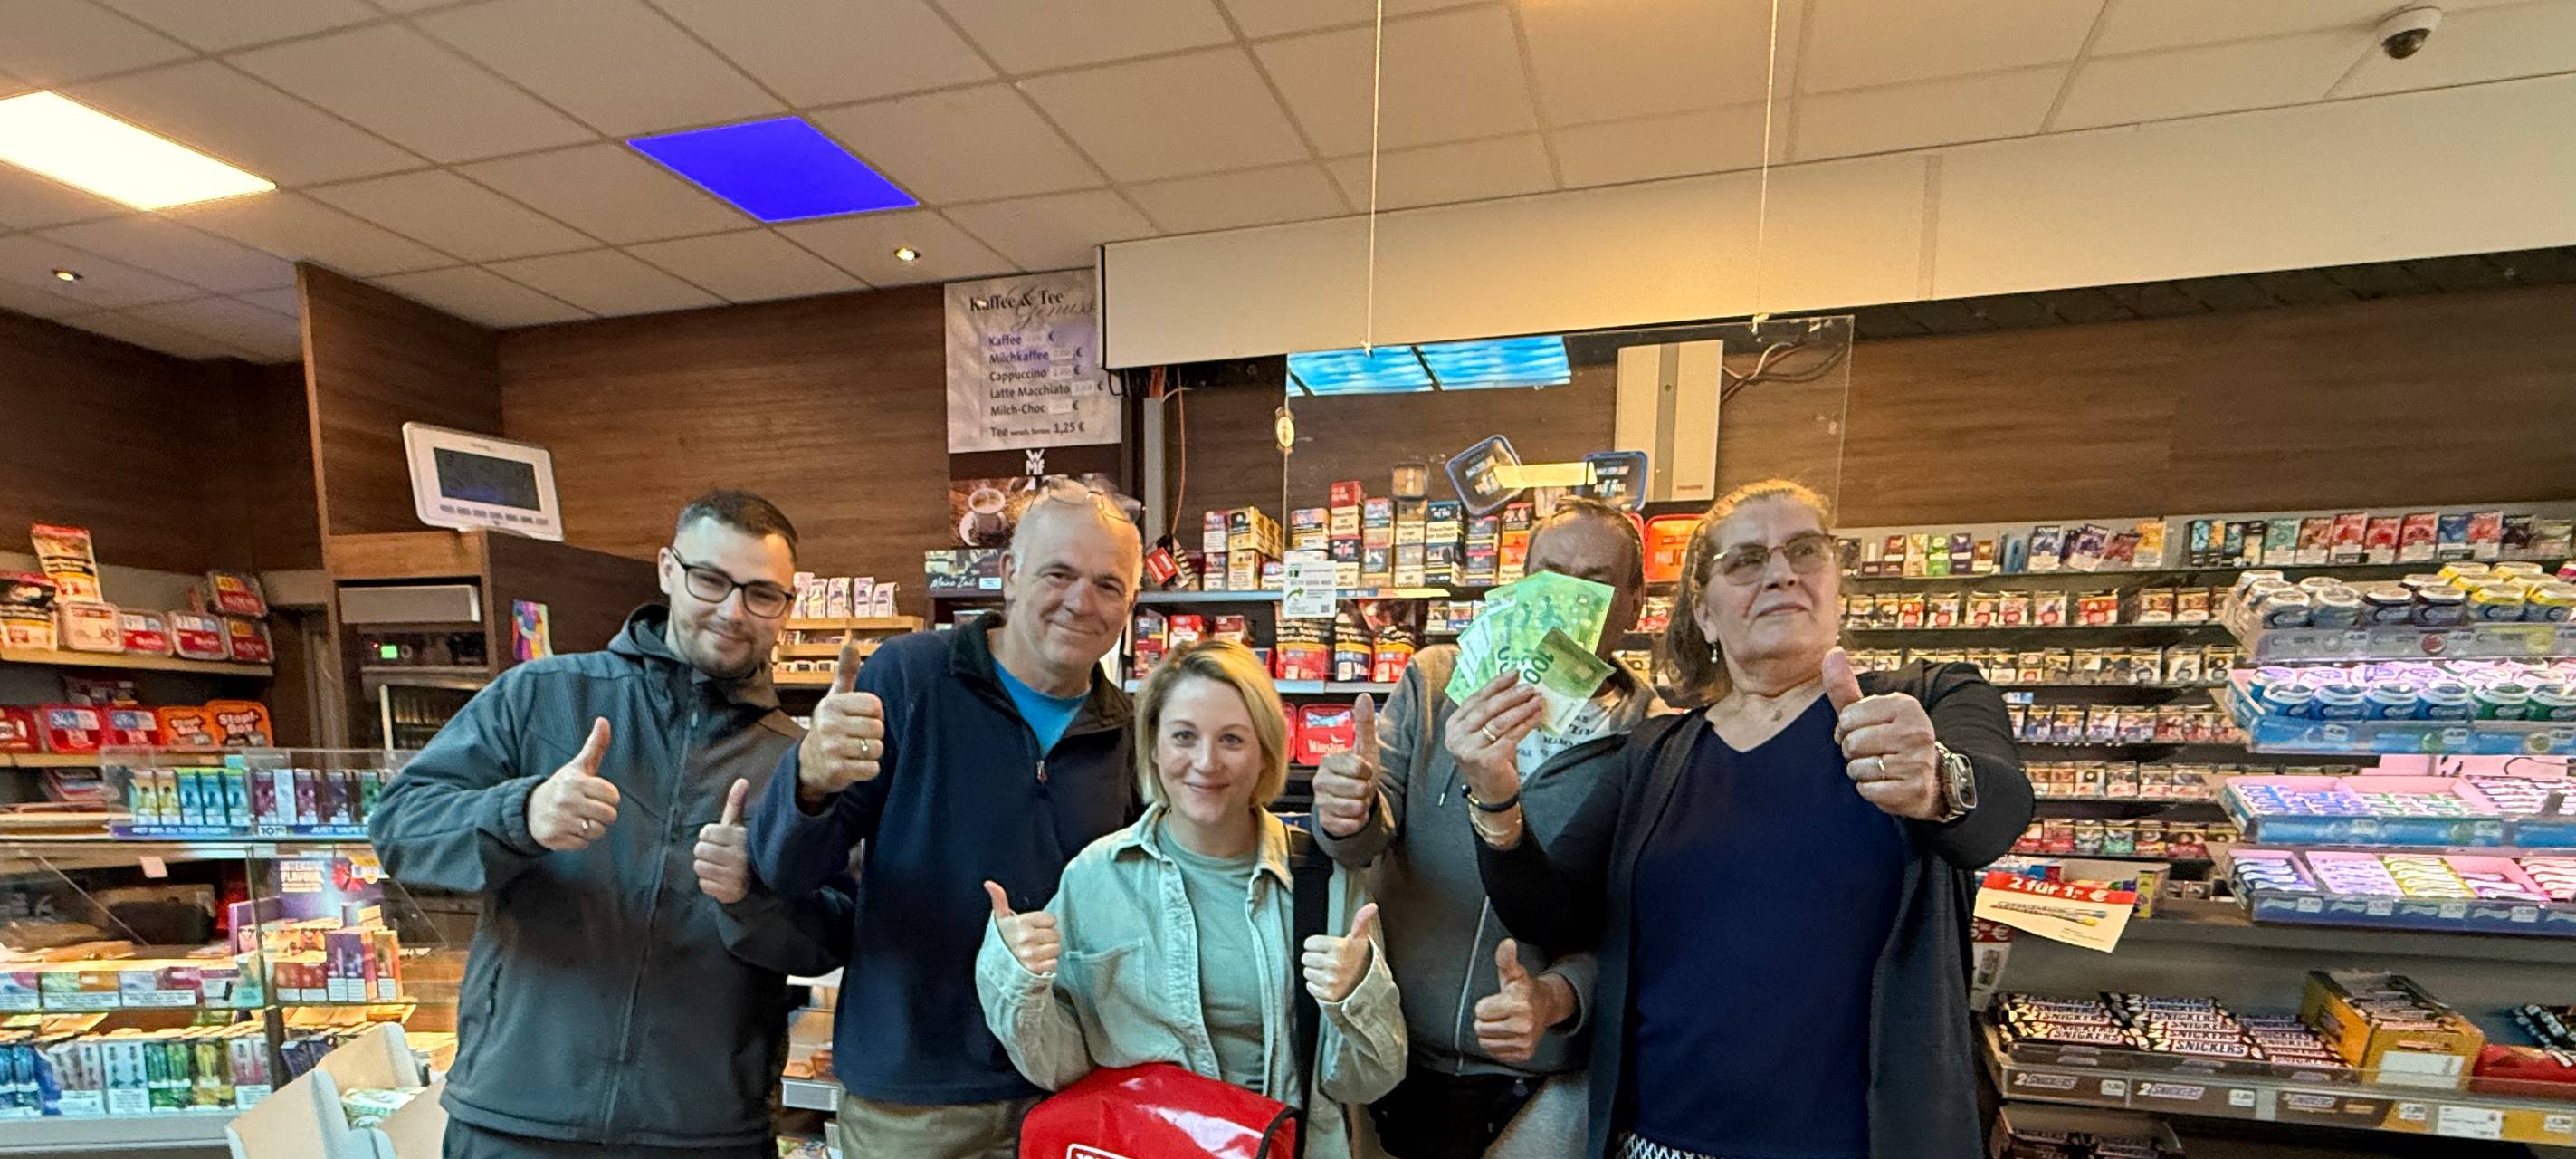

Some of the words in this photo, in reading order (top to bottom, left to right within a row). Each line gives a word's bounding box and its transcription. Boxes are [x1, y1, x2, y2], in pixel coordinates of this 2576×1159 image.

[970, 295, 1015, 311] Kaffee
[1041, 290, 1064, 305] Tee
[988, 334, 1022, 347] Kaffee
[1048, 330, 1055, 342] €
[989, 350, 1050, 364] Milchkaffee
[1075, 347, 1083, 358] €
[989, 368, 1047, 384] Cappuccino
[1073, 364, 1081, 376] €
[990, 387, 1016, 399] Latte
[1018, 383, 1071, 398] Macchiato
[1097, 380, 1103, 391] €
[990, 404, 1045, 417] Milch-Choc
[1072, 399, 1079, 411] €
[991, 426, 1008, 437] Tee
[1054, 422, 1075, 436] 1,25
[1078, 422, 1085, 432] €
[1523, 649, 1554, 685] 100
[2008, 876, 2024, 890] 2
[2026, 878, 2060, 896] für
[2089, 889, 2110, 903] €
[2043, 1011, 2107, 1023] SNICKERS
[2053, 1030, 2120, 1041] SNICKERS
[2175, 1040, 2247, 1055] SNICKERS
